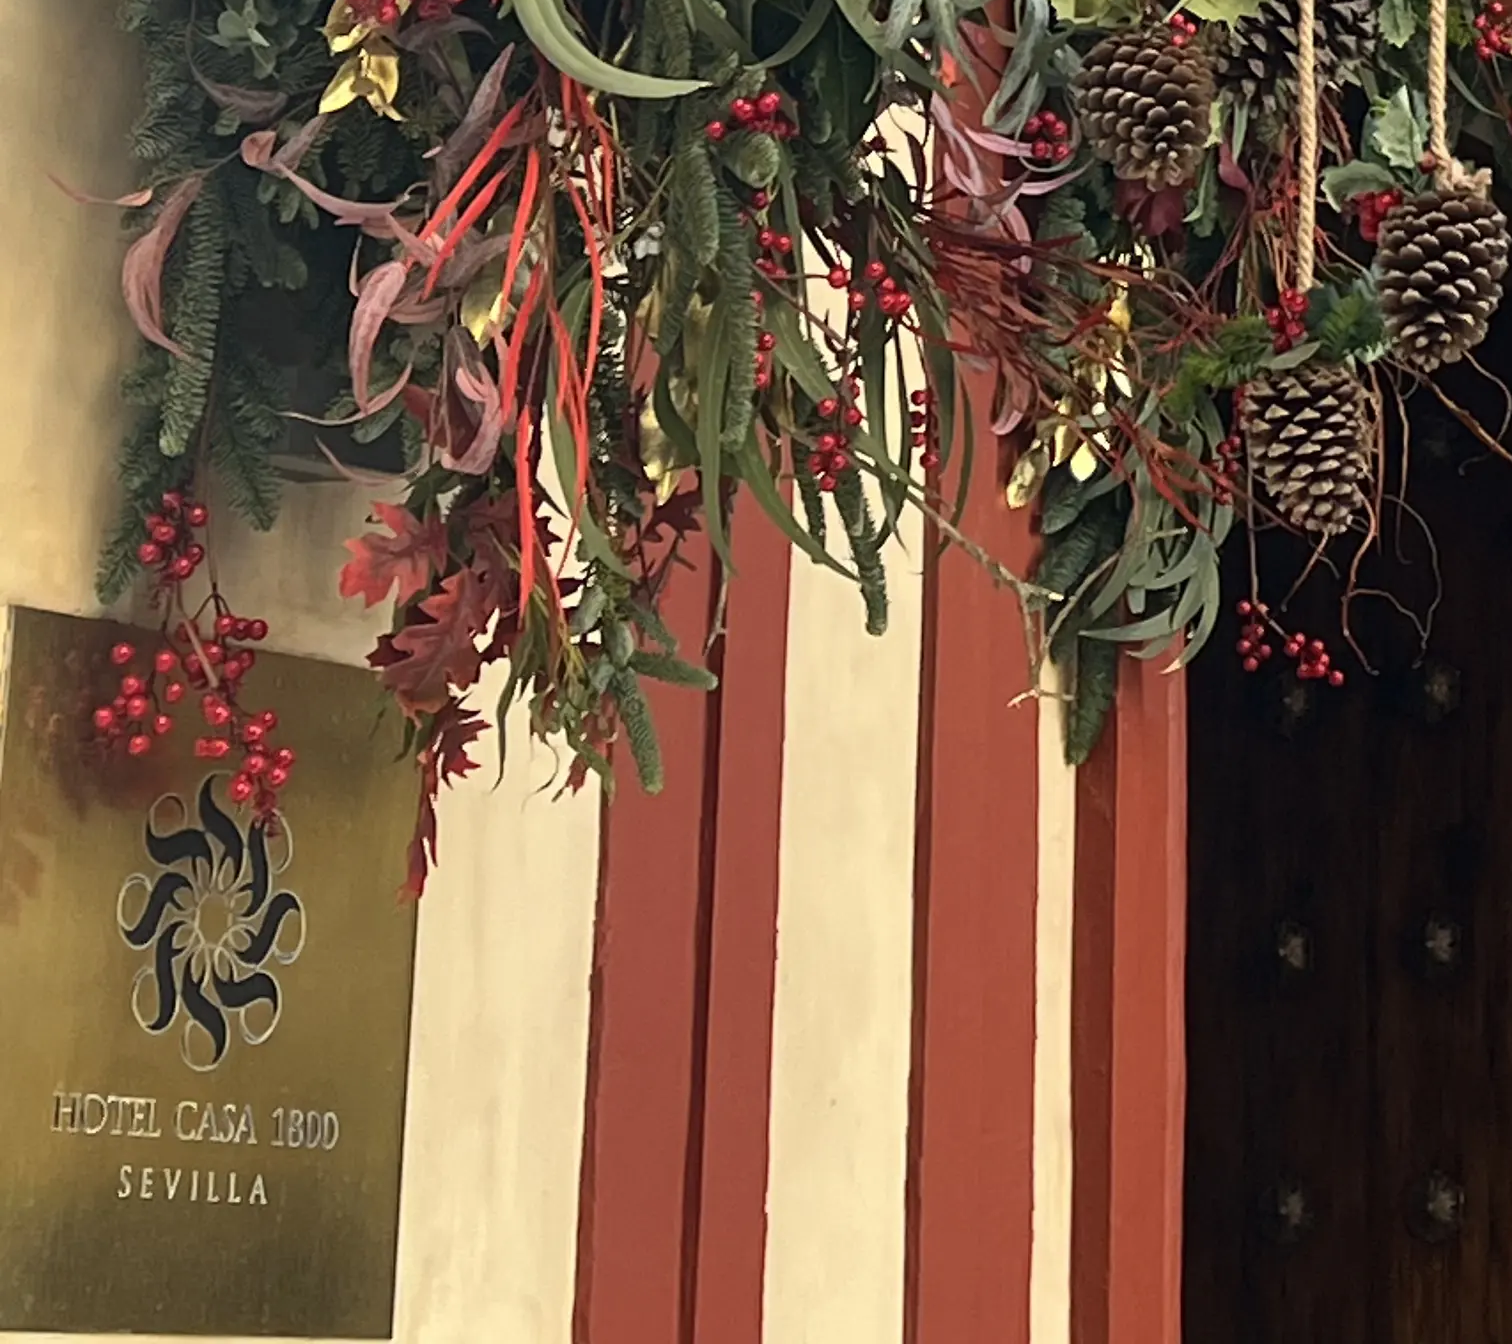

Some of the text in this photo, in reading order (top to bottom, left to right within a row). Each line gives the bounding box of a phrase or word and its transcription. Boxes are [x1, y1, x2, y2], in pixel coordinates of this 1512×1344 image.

[51, 1090, 340, 1151] HOTEL CASA 1800
[116, 1165, 269, 1205] SEVILLA
